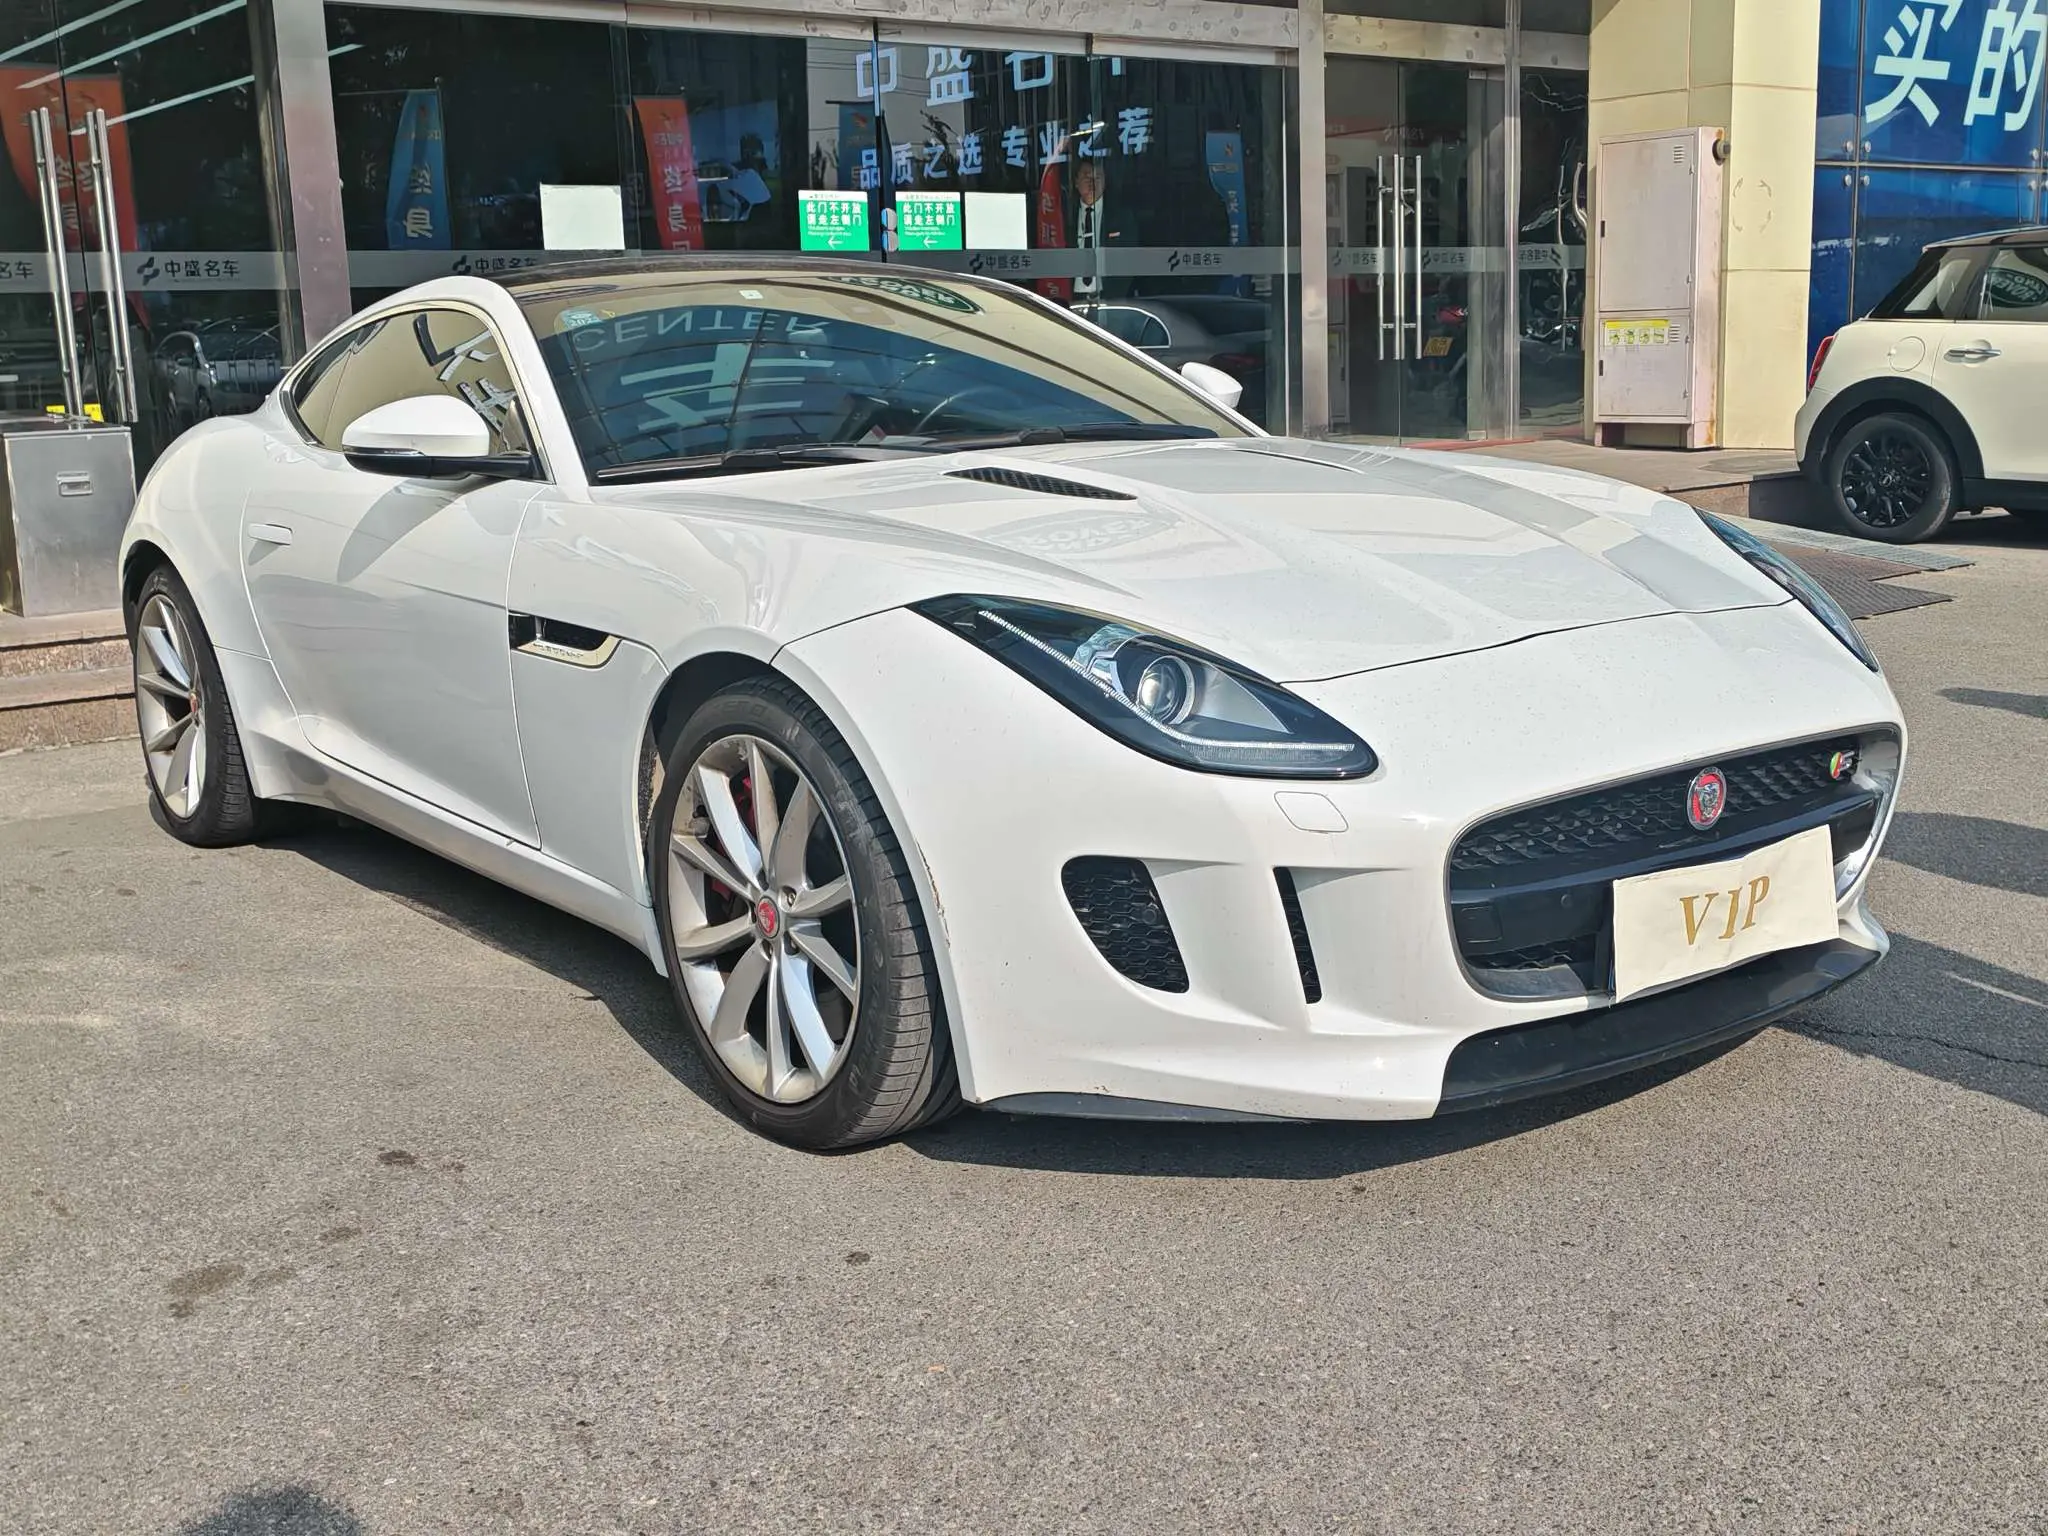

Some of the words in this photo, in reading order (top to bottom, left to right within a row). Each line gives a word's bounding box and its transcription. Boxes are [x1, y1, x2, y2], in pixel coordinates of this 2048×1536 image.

[860, 133, 983, 189] 品质之选
[1001, 107, 1152, 167] 专业之荐
[164, 259, 240, 278] 中盛名车
[1680, 875, 1770, 946] VIP
